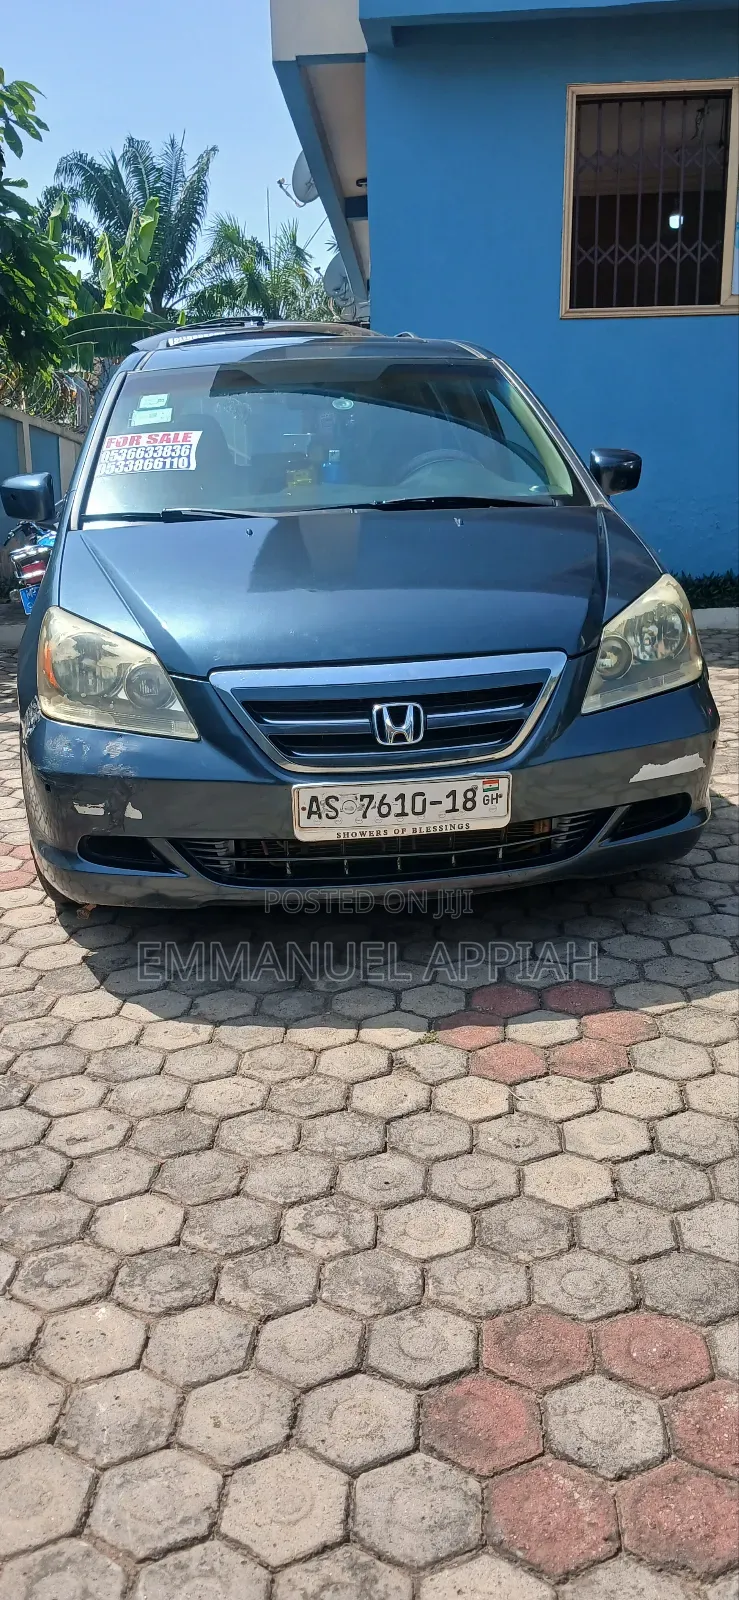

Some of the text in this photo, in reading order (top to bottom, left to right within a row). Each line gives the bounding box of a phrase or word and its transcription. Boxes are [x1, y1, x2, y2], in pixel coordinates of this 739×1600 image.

[107, 432, 193, 449] FOR SALE
[306, 788, 478, 820] AS 7610-18
[482, 793, 499, 805] GH
[336, 822, 471, 839] SHOWERS OF BLESSINGS
